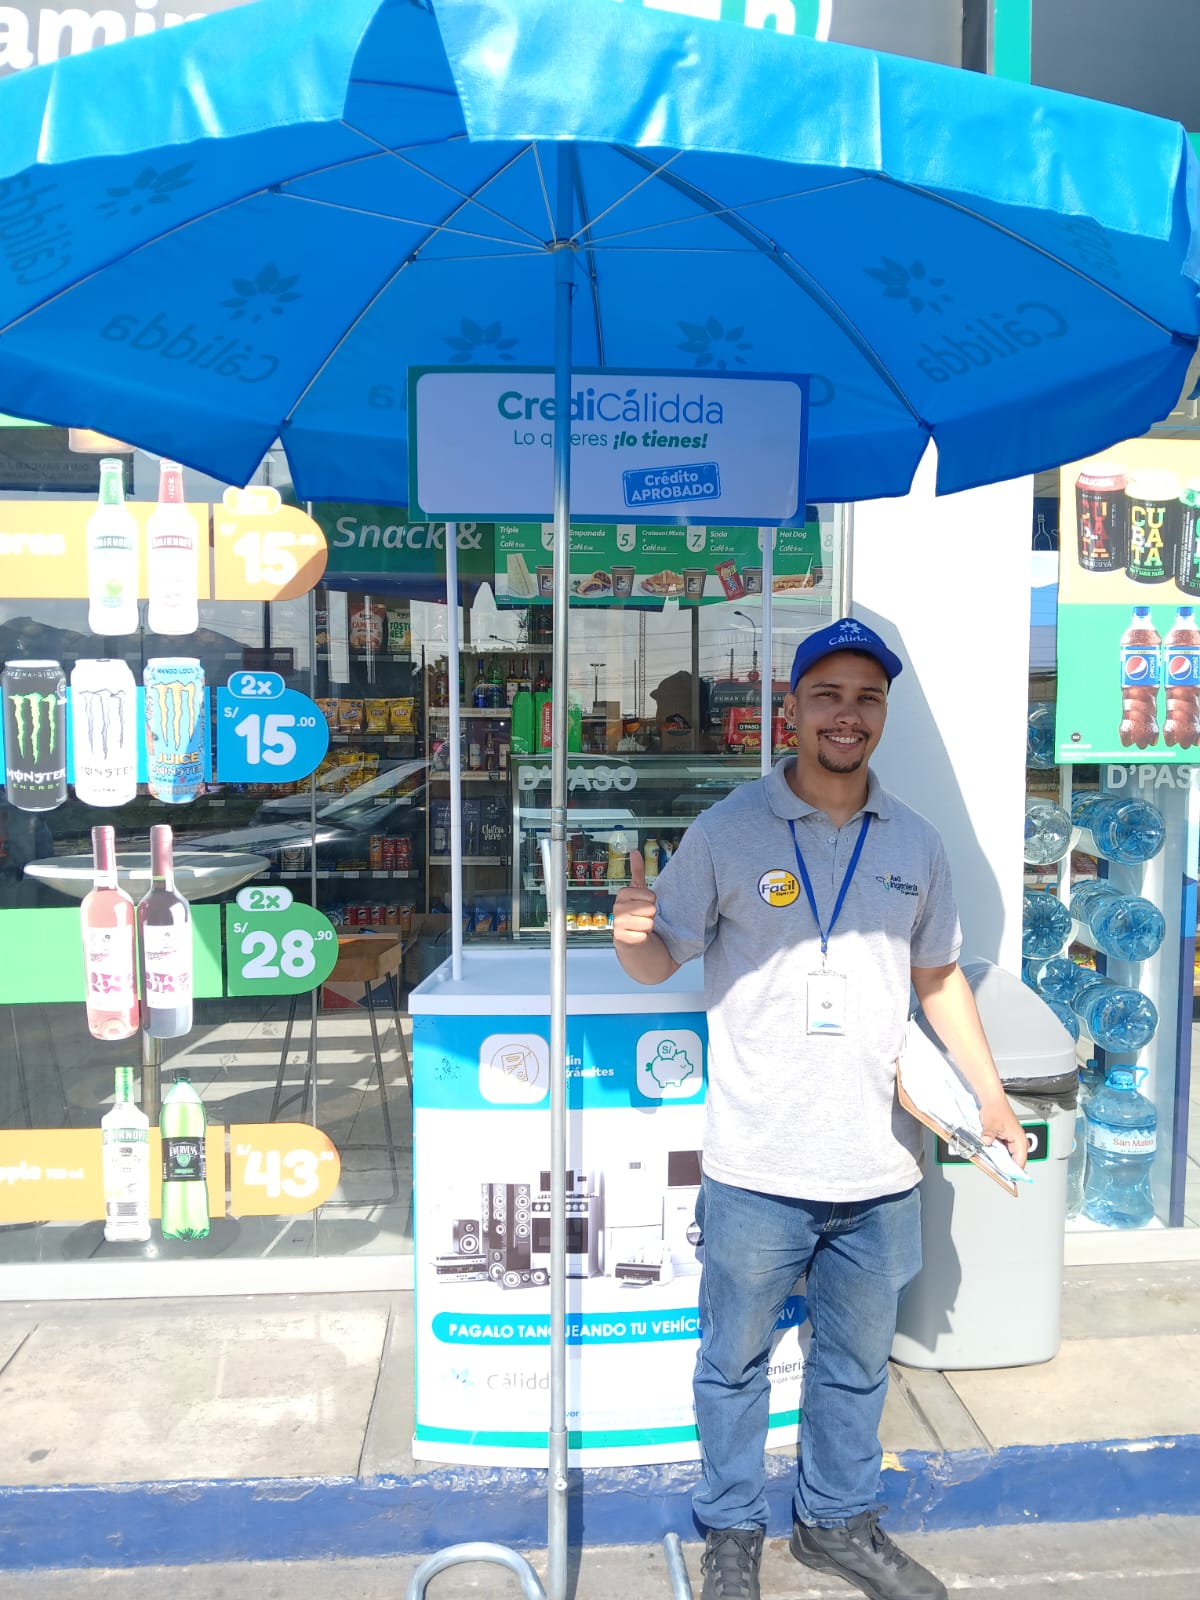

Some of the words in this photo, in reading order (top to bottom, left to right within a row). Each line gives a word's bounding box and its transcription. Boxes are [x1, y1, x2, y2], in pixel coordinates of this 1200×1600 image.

[514, 430, 534, 446] Lo
[537, 431, 607, 450] qeres
[613, 431, 637, 449] ¡lo
[642, 431, 707, 449] tienes!
[645, 471, 699, 487] Crédito
[631, 481, 714, 502] APROBADO
[333, 516, 446, 549] Snack
[619, 533, 630, 547] 5
[692, 533, 702, 548] 7
[240, 675, 272, 695] 2x
[223, 706, 239, 719] S/
[157, 752, 200, 765] JUICE
[518, 765, 638, 791] D'ASO
[1107, 765, 1191, 789] D'PAS
[761, 879, 795, 894] Facil
[249, 890, 280, 909] 2x
[233, 922, 249, 934] S/
[243, 1149, 320, 1199] 43
[449, 1322, 514, 1339] PAGALO
[517, 1321, 626, 1339] TANEANDO
[631, 1321, 647, 1336] TU
